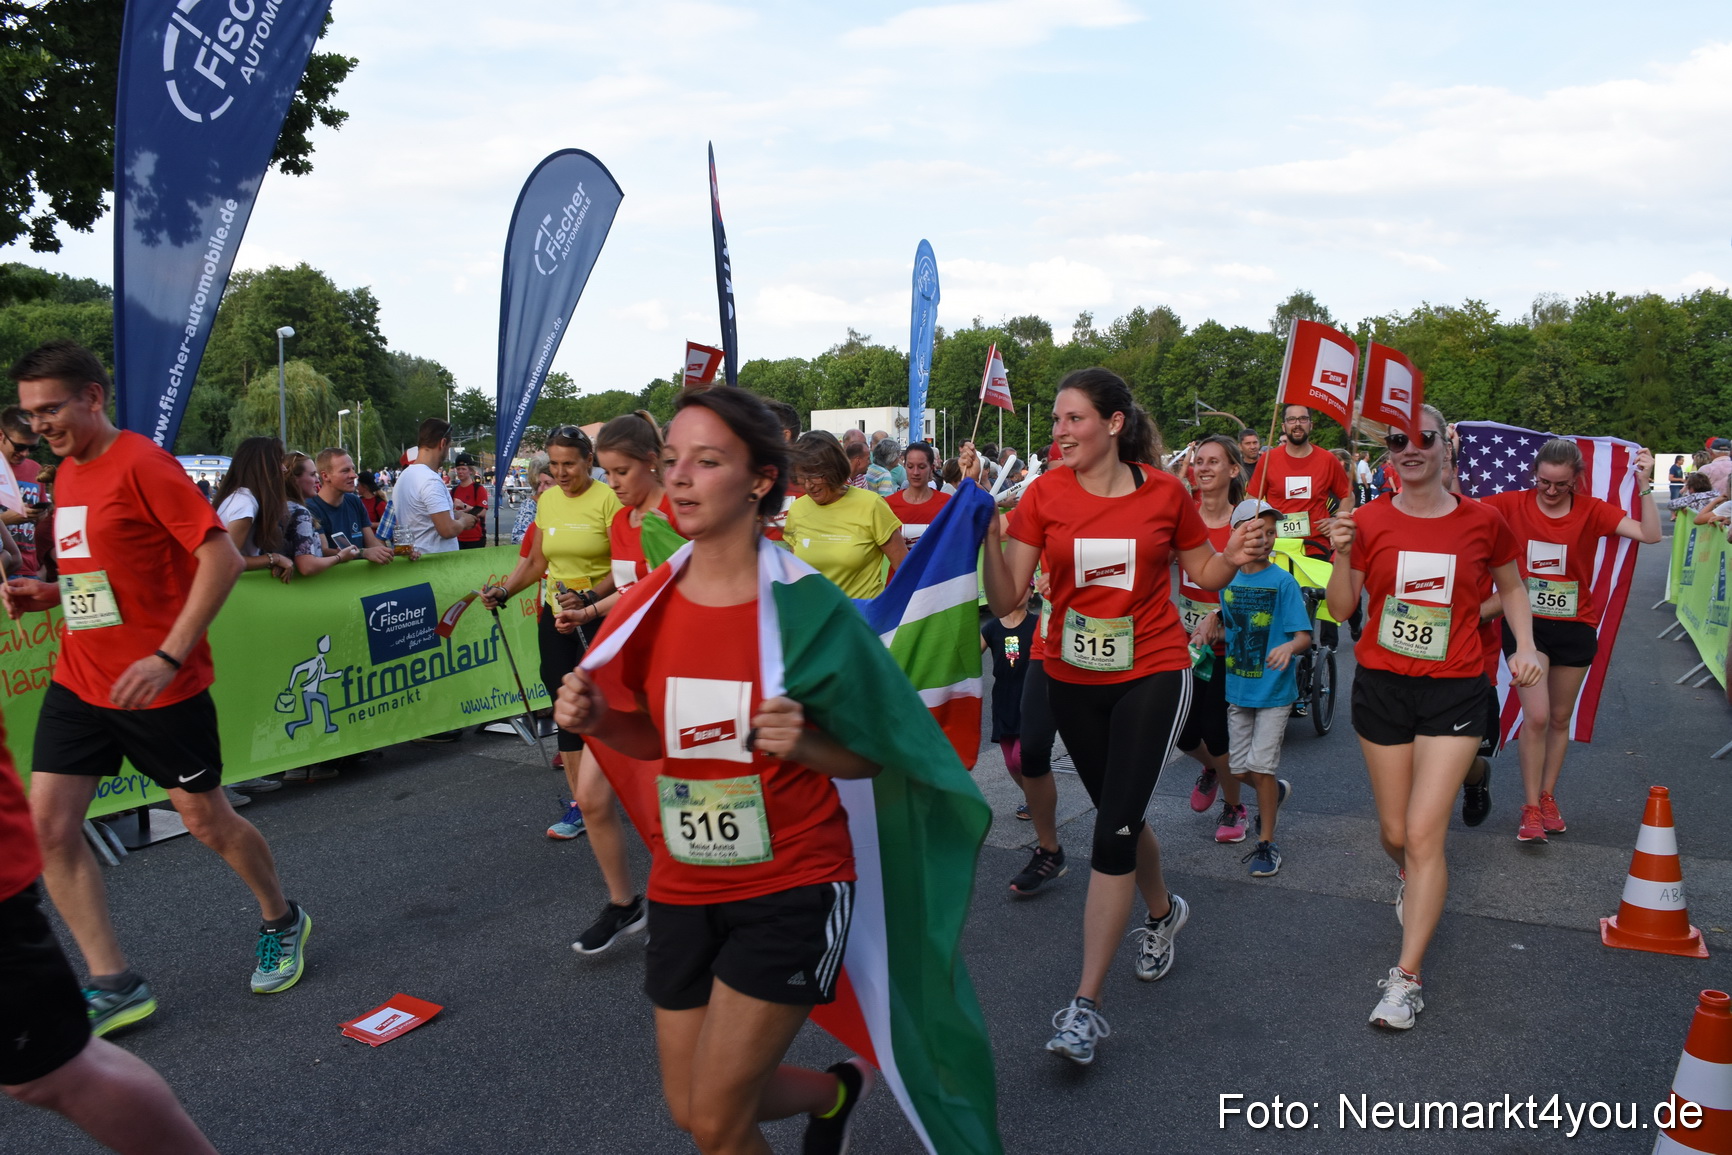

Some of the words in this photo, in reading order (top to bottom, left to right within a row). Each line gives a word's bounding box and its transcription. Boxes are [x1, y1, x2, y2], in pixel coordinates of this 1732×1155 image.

[240, 0, 283, 85] AUTOM
[545, 181, 586, 262] Fischer
[561, 196, 592, 260] AUTOMOBILE
[1309, 389, 1328, 402] DEHN
[1283, 521, 1301, 532] 501
[1415, 581, 1434, 589] DEHN
[70, 594, 96, 615] 537
[1536, 592, 1567, 608] 556
[380, 607, 427, 627] Fischer
[386, 618, 424, 633] AUTOMOBILE
[1392, 619, 1433, 645] 538
[1074, 633, 1116, 657] 515
[341, 624, 500, 707] firmenlauf
[1074, 652, 1090, 661] Luber
[348, 689, 422, 724] neumarkt
[693, 727, 722, 742] DEHN
[680, 811, 739, 842] 516
